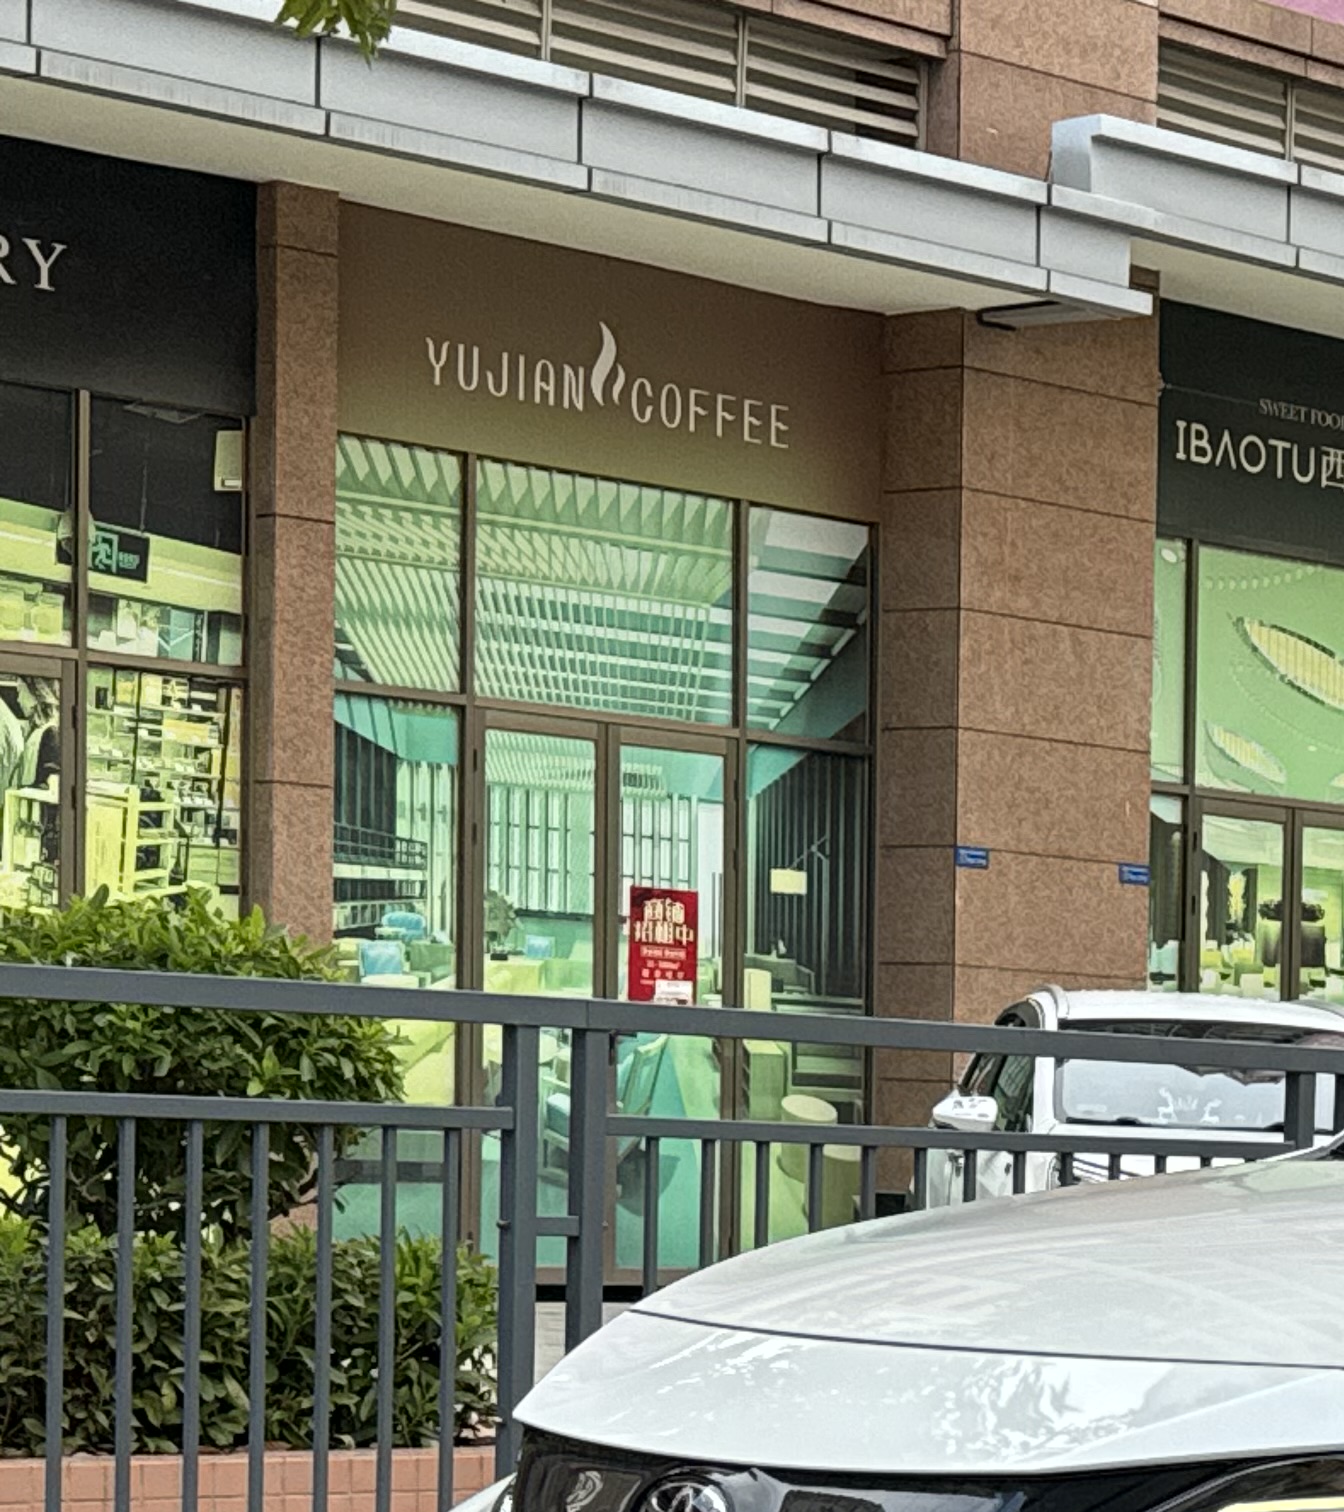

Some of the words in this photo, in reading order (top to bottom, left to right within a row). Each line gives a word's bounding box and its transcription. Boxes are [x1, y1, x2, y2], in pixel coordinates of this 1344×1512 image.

[425, 336, 585, 412] YUJIAN
[631, 377, 790, 449] COFFEE
[1259, 398, 1307, 424] SWEET
